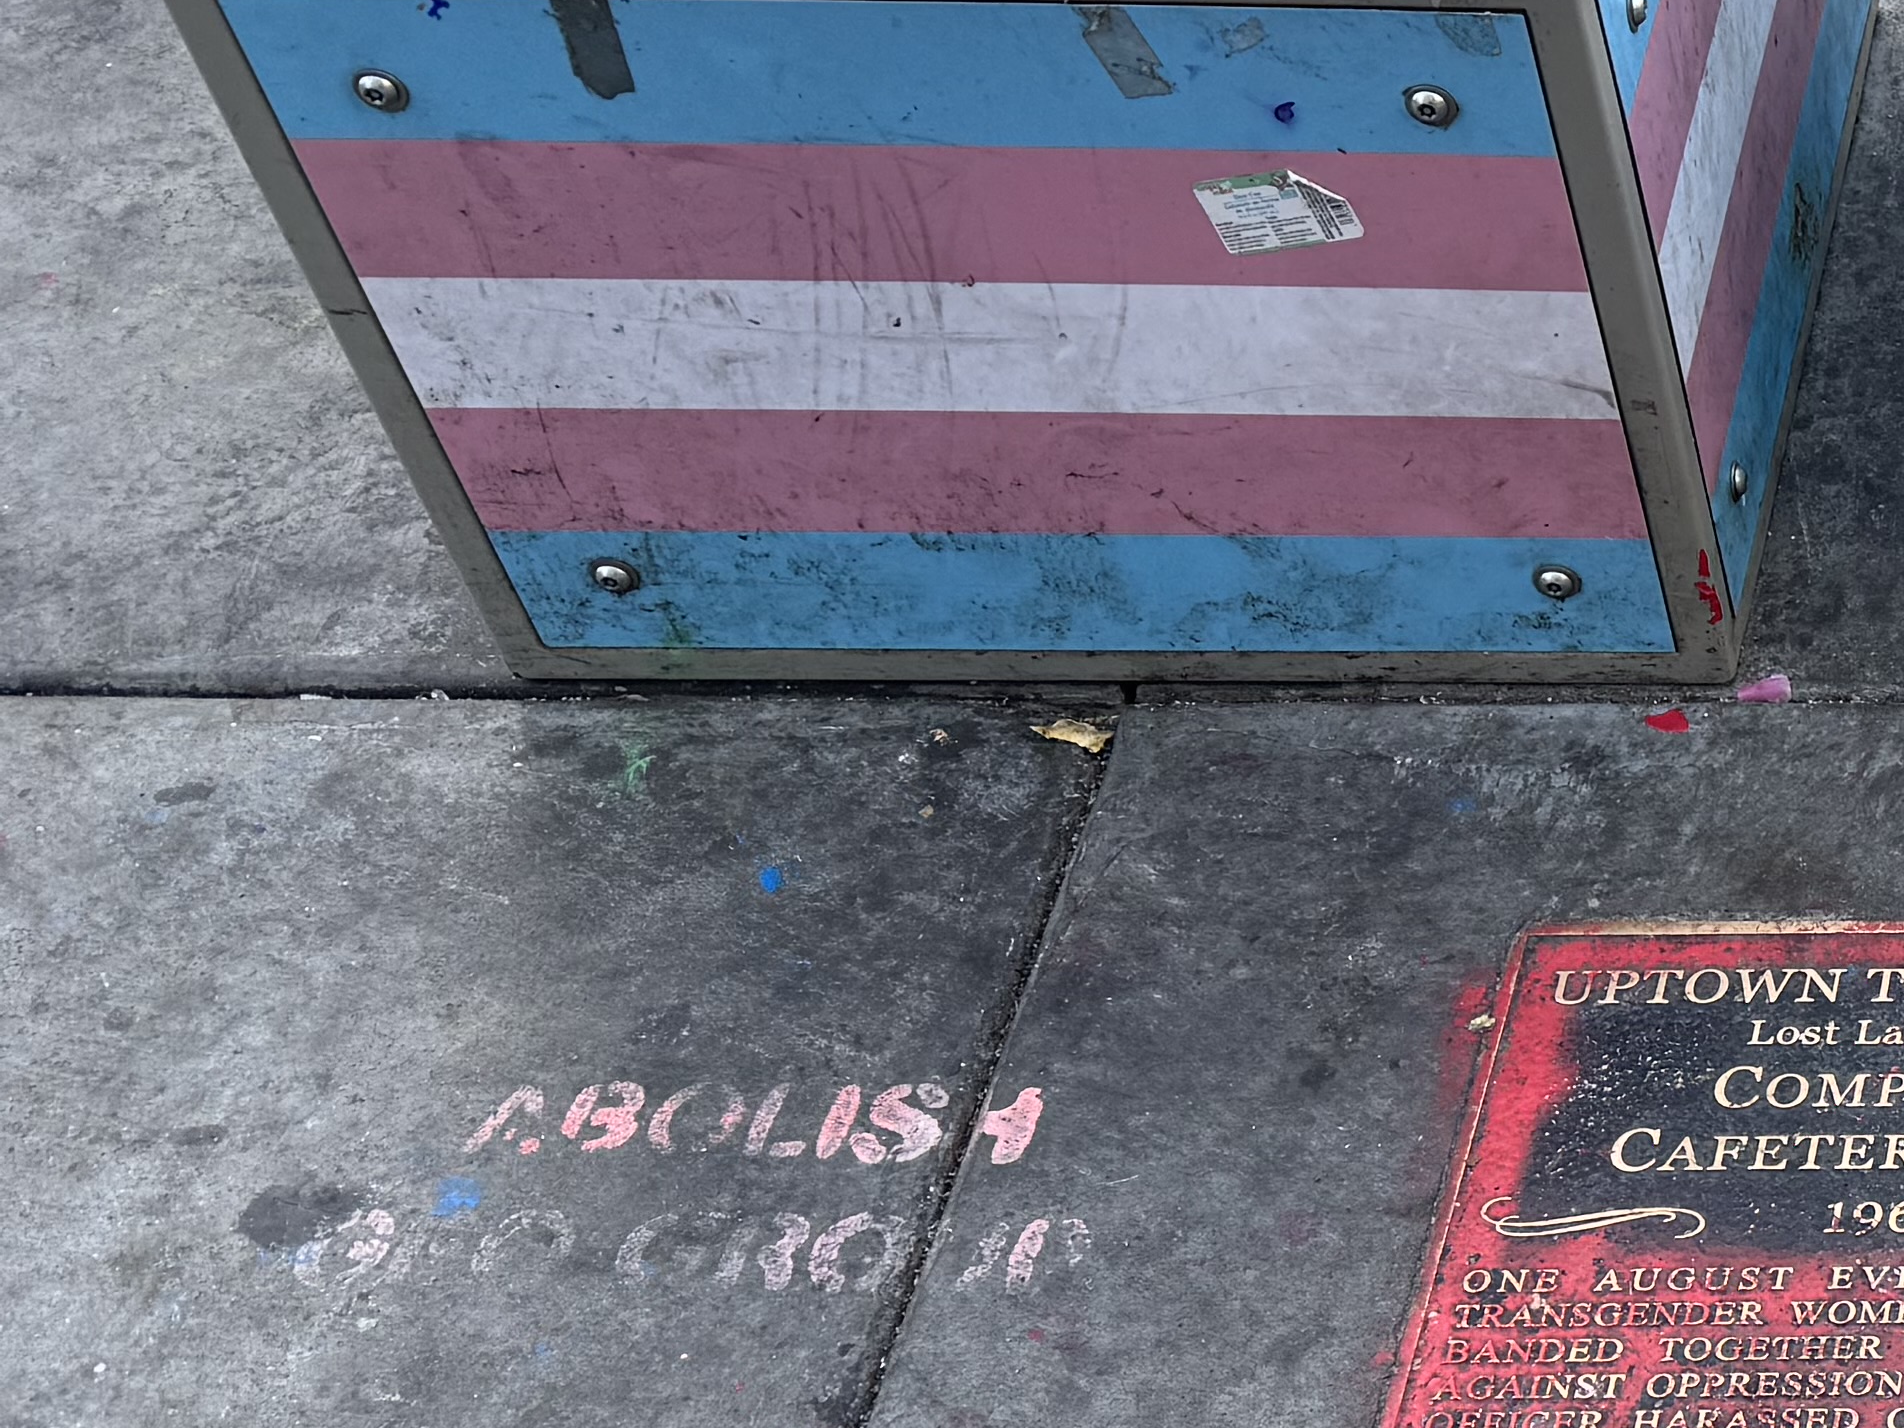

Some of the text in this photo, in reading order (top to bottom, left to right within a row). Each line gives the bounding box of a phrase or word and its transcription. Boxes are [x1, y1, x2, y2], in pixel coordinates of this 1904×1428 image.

[1554, 968, 1844, 1005] UPTOWN
[1748, 1018, 1839, 1047] Lost
[1462, 1265, 1561, 1294] ONE
[1594, 1265, 1794, 1293] AUGUST
[1453, 1301, 1766, 1329] TRANSGENDER
[1443, 1336, 1625, 1365] BANDED
[1660, 1335, 1883, 1362] TOGETHER
[1430, 1372, 1626, 1400] AGAINST
[1645, 1371, 1903, 1399] OPPRESSION
